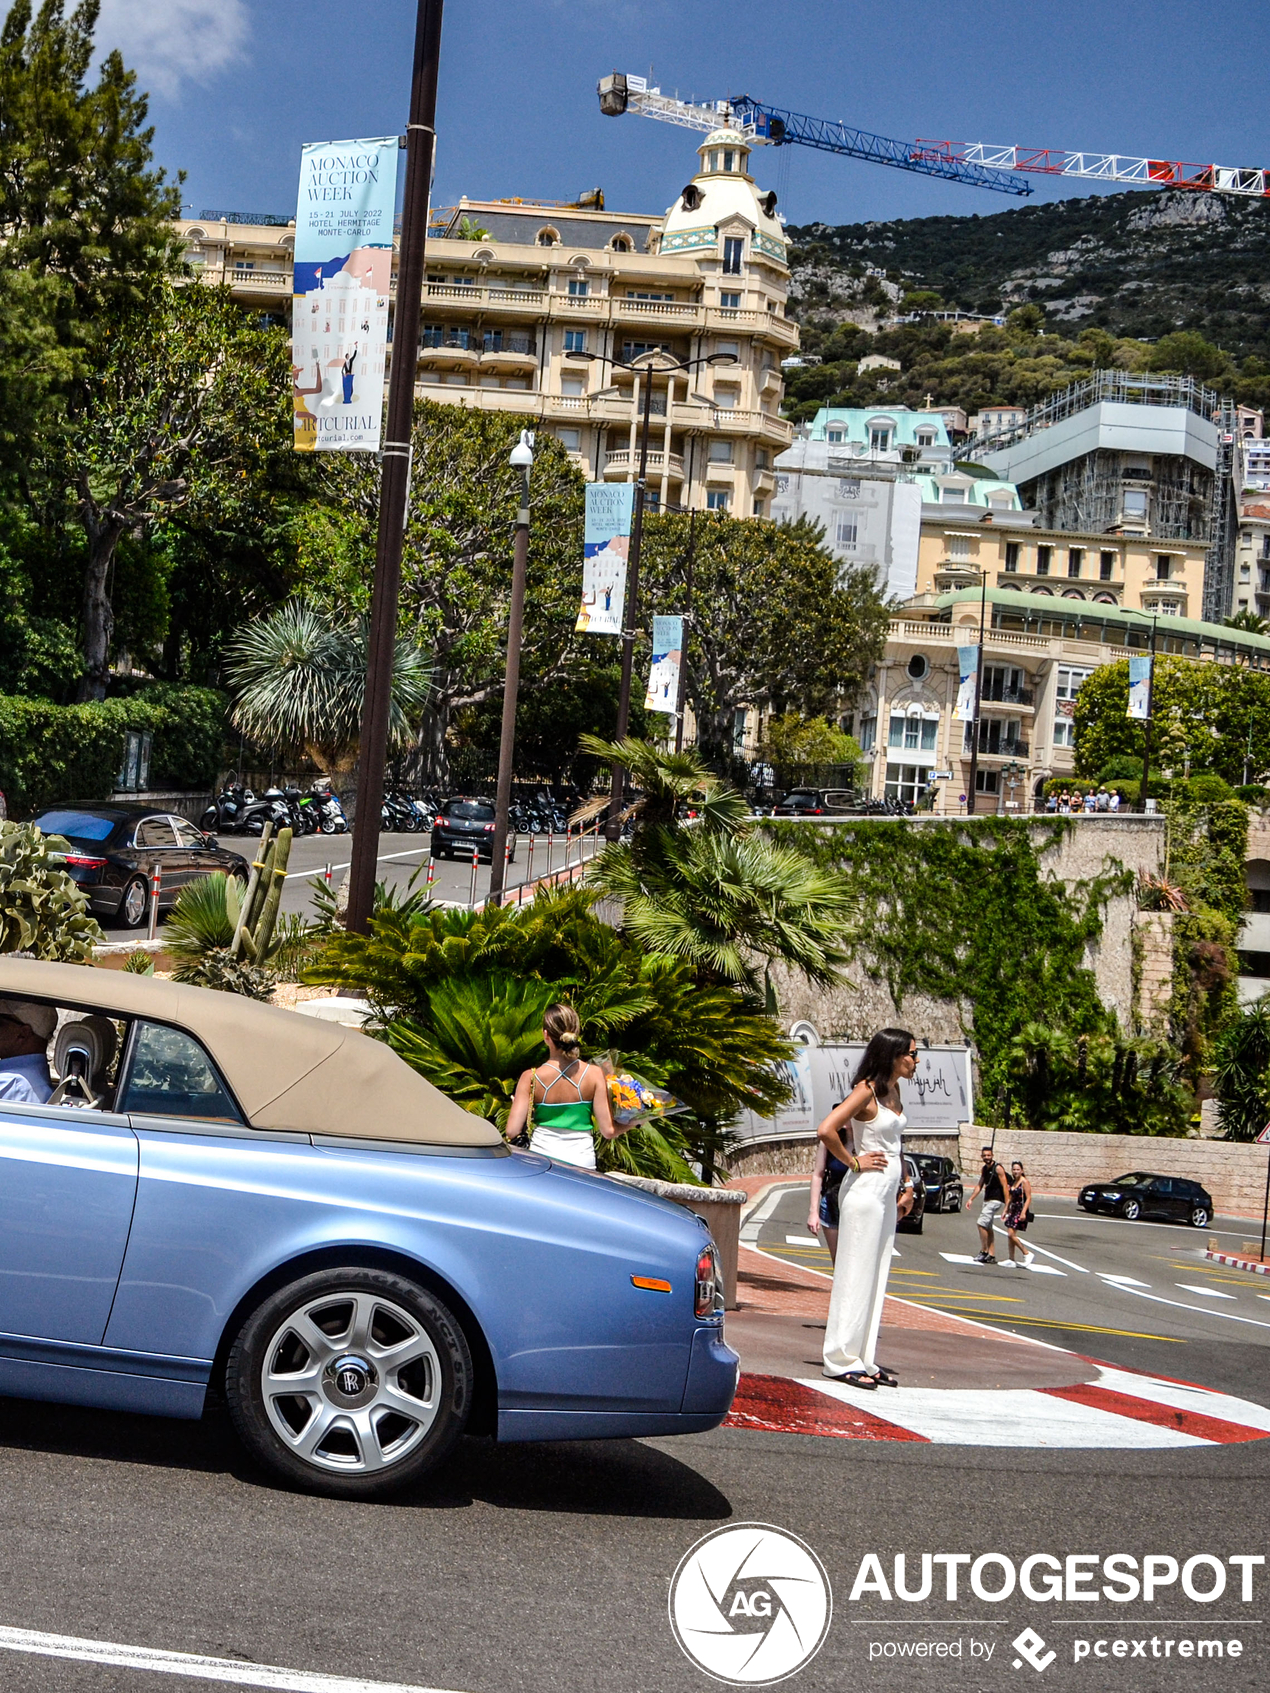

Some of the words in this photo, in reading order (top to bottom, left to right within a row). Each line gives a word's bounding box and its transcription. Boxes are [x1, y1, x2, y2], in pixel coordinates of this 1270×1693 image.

[310, 154, 379, 171] MONACO
[308, 170, 379, 186] AUCTION
[308, 186, 352, 201] WEEK
[340, 210, 359, 218] JULY
[364, 210, 382, 218] 2022
[338, 219, 380, 227] HERMITAGE
[310, 434, 363, 443] artcurial.com
